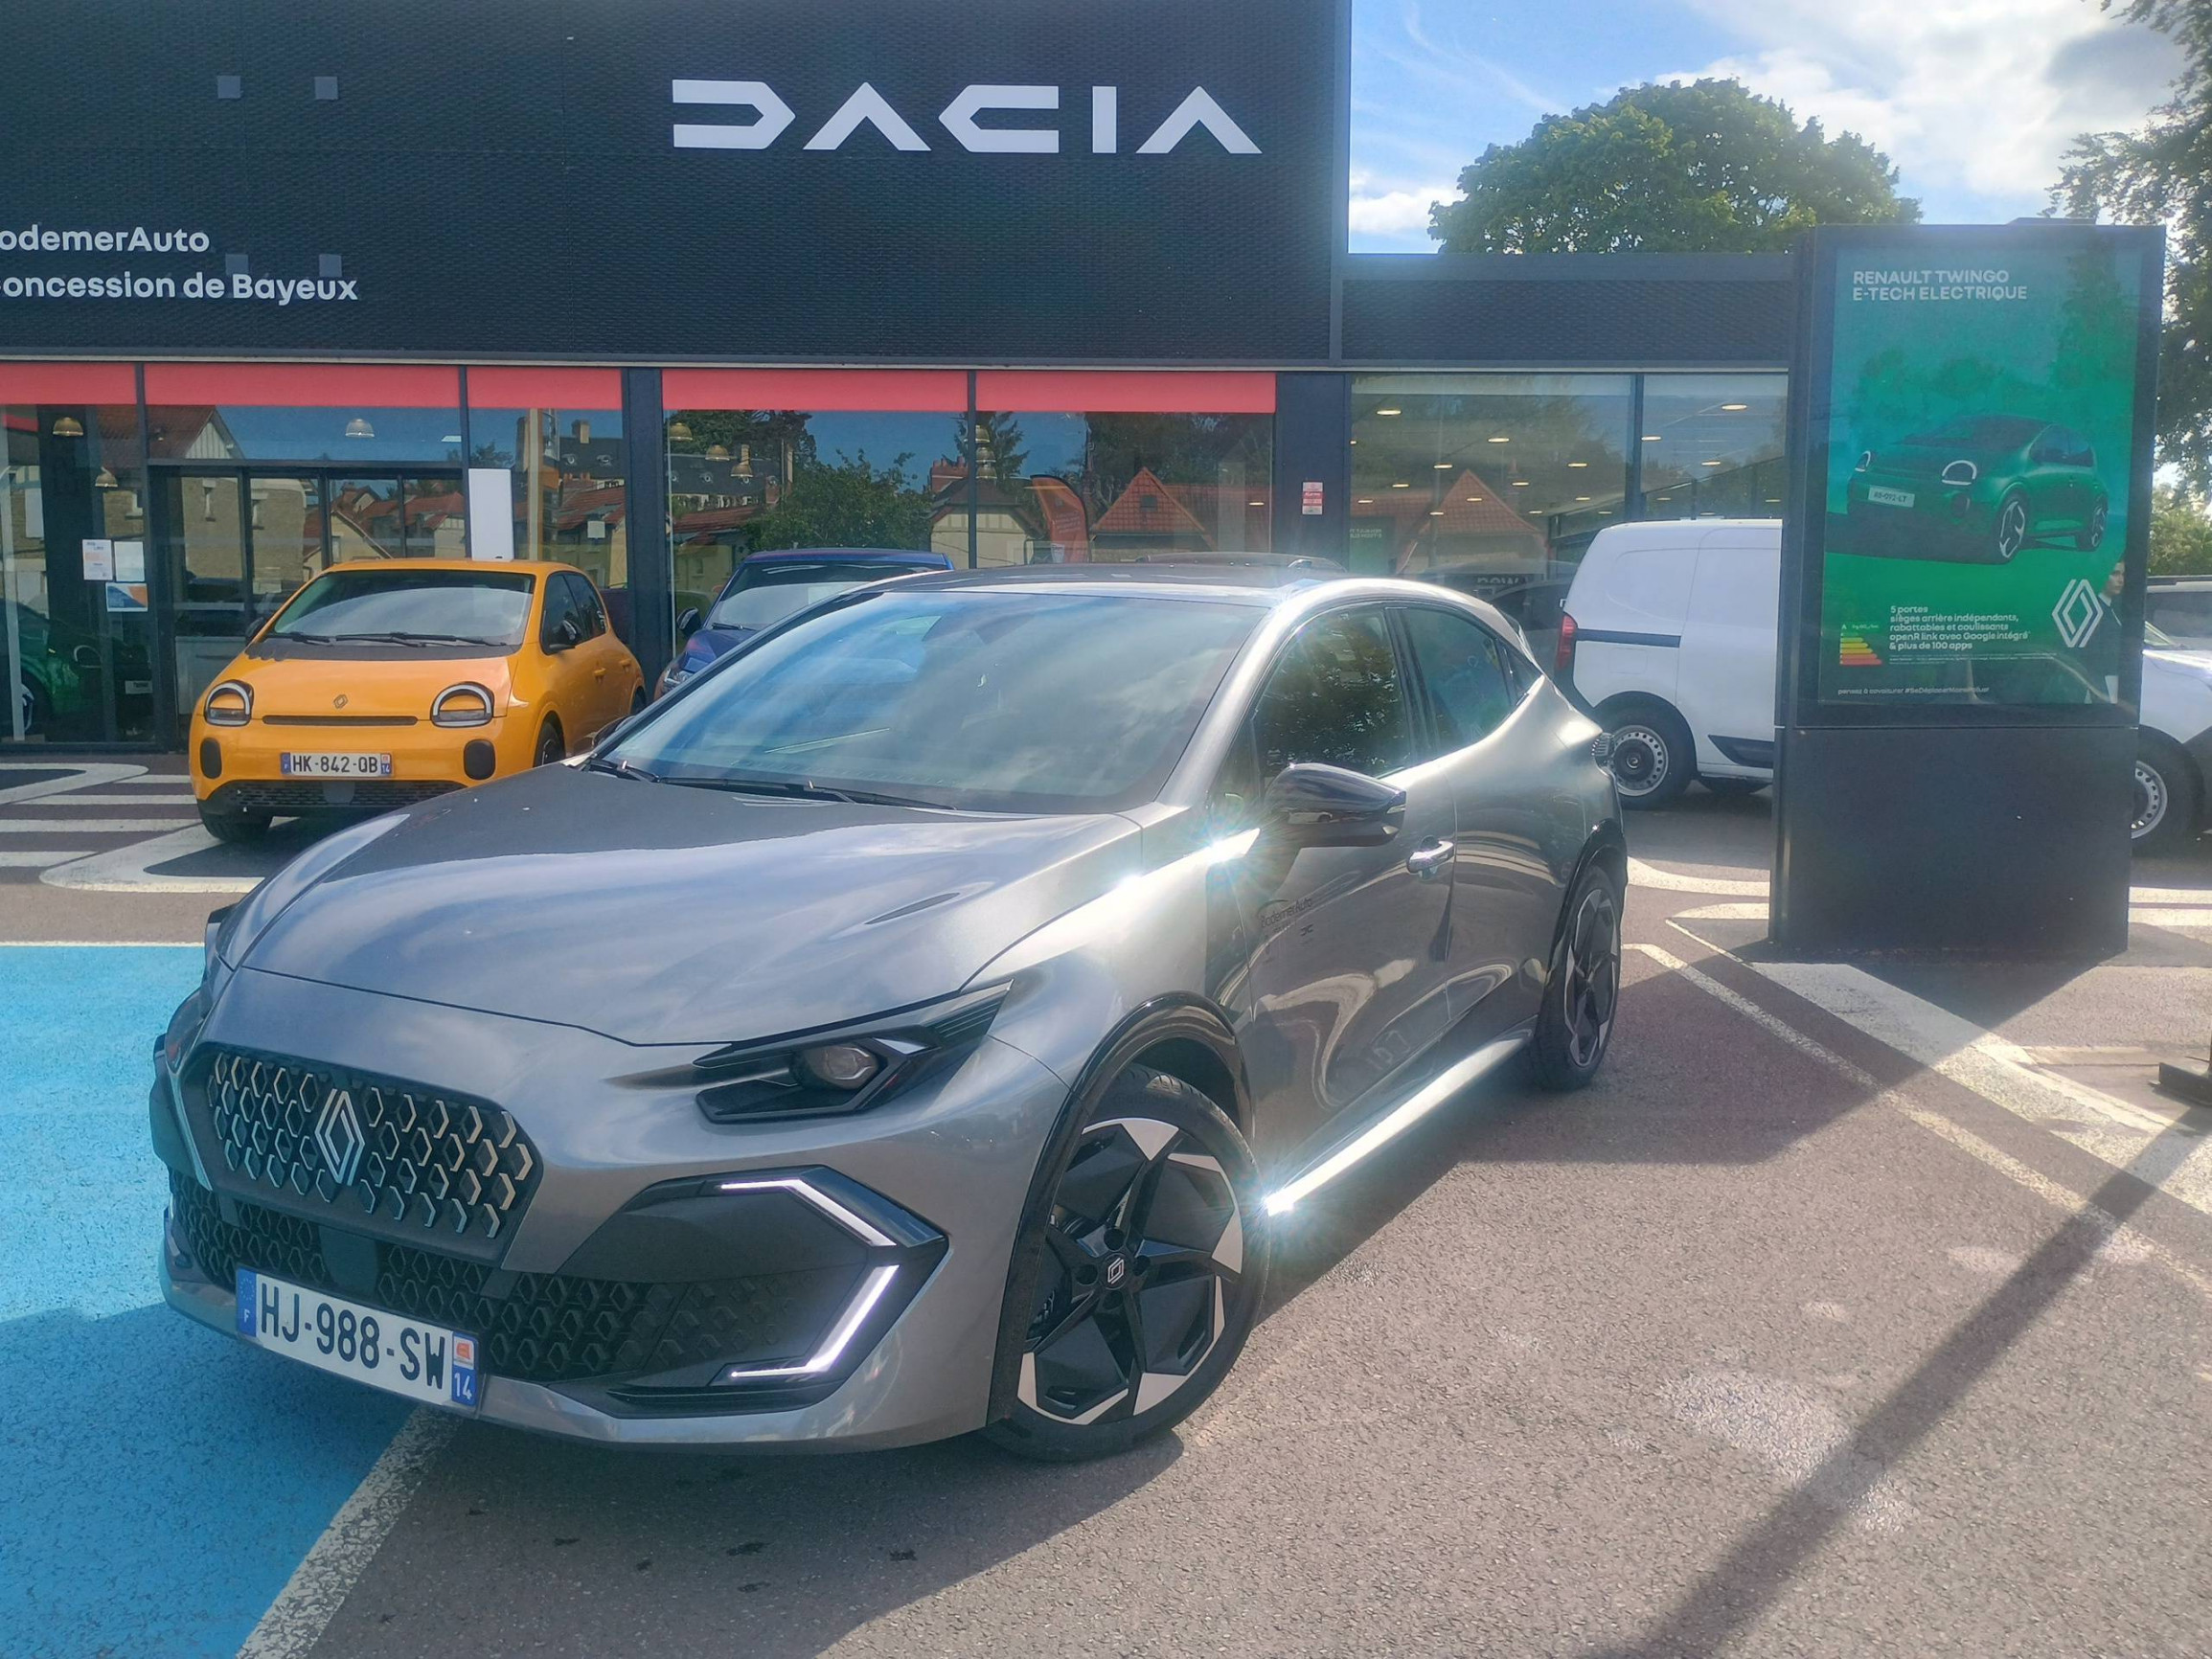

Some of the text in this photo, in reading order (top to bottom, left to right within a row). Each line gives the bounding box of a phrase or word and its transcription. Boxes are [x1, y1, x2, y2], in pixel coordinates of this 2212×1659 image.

[673, 79, 1263, 154] DACIA
[1854, 270, 2009, 284] RENAULT TWINGO
[0, 271, 358, 306] oncession de Bayeux
[1853, 285, 2027, 301] E-TECH ELECTRIQUE
[1963, 632, 1995, 642] Google
[1918, 641, 1931, 649] de
[1931, 641, 1949, 649] 100
[1949, 642, 1973, 651] apps
[243, 1282, 473, 1401] F HJ-988-SW 14
